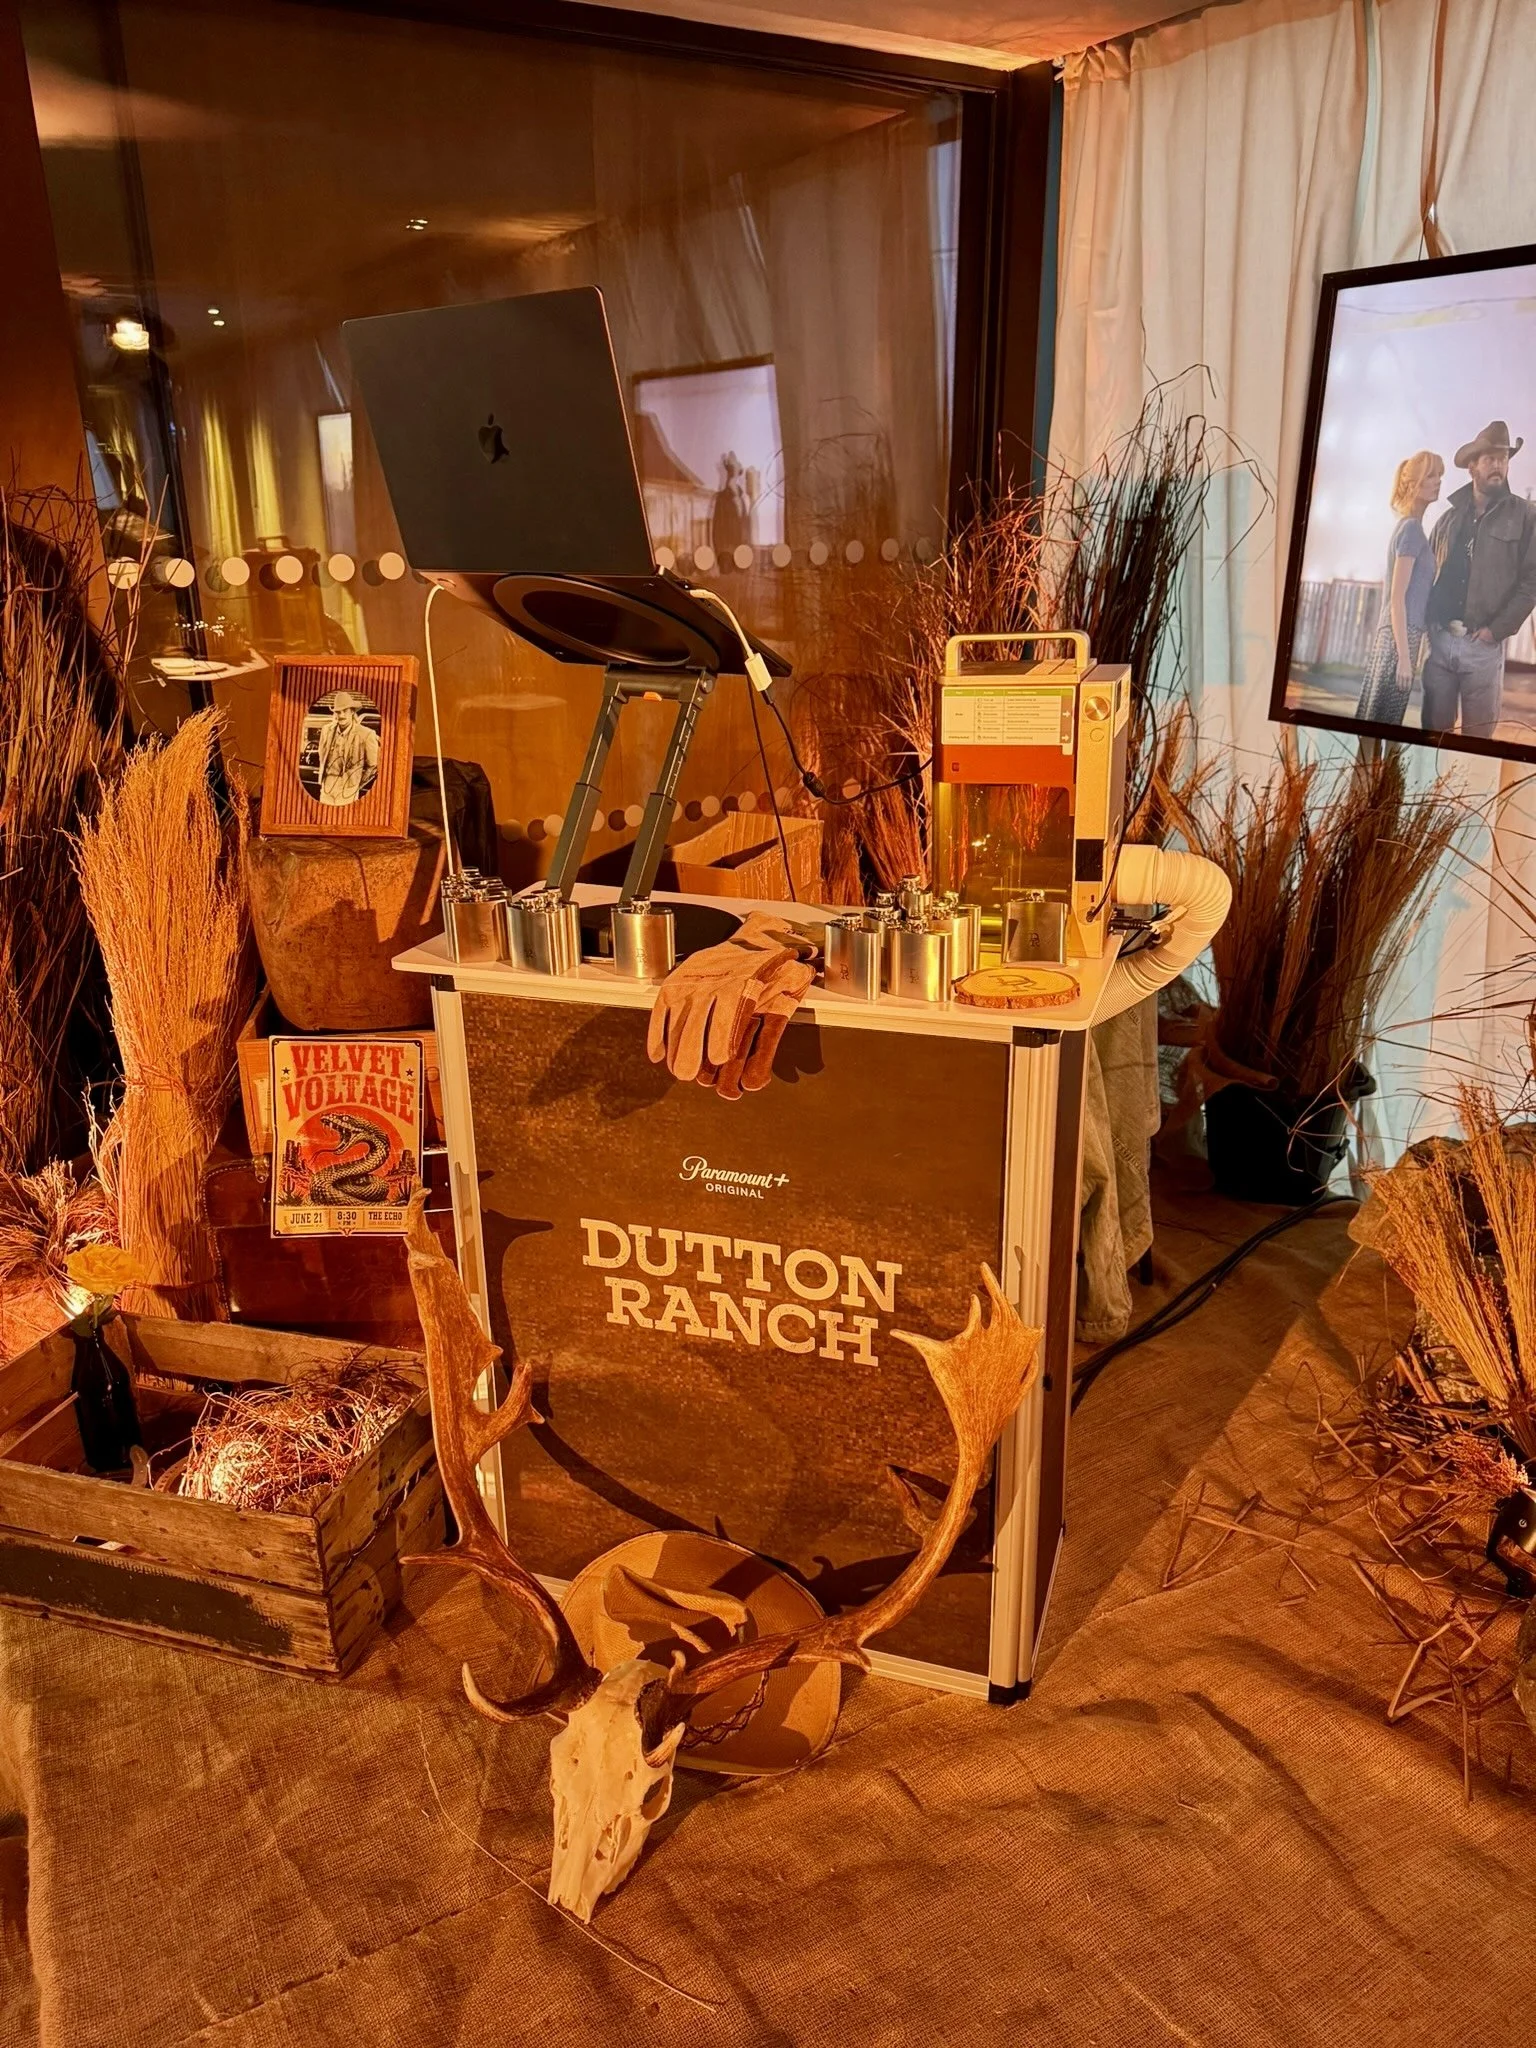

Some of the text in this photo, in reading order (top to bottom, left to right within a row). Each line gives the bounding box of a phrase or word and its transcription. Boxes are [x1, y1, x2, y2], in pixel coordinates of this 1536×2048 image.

[290, 1044, 405, 1078] VELVET
[282, 1074, 415, 1126] VOLTAGE
[679, 1155, 790, 1188] Paramount+
[705, 1182, 764, 1199] ORIGINAL
[290, 1212, 322, 1224] JUNE 21
[337, 1211, 357, 1221] 8:30
[368, 1211, 403, 1221] THE ECHO
[580, 1218, 903, 1313] DUTTON
[604, 1276, 879, 1367] RANCH
